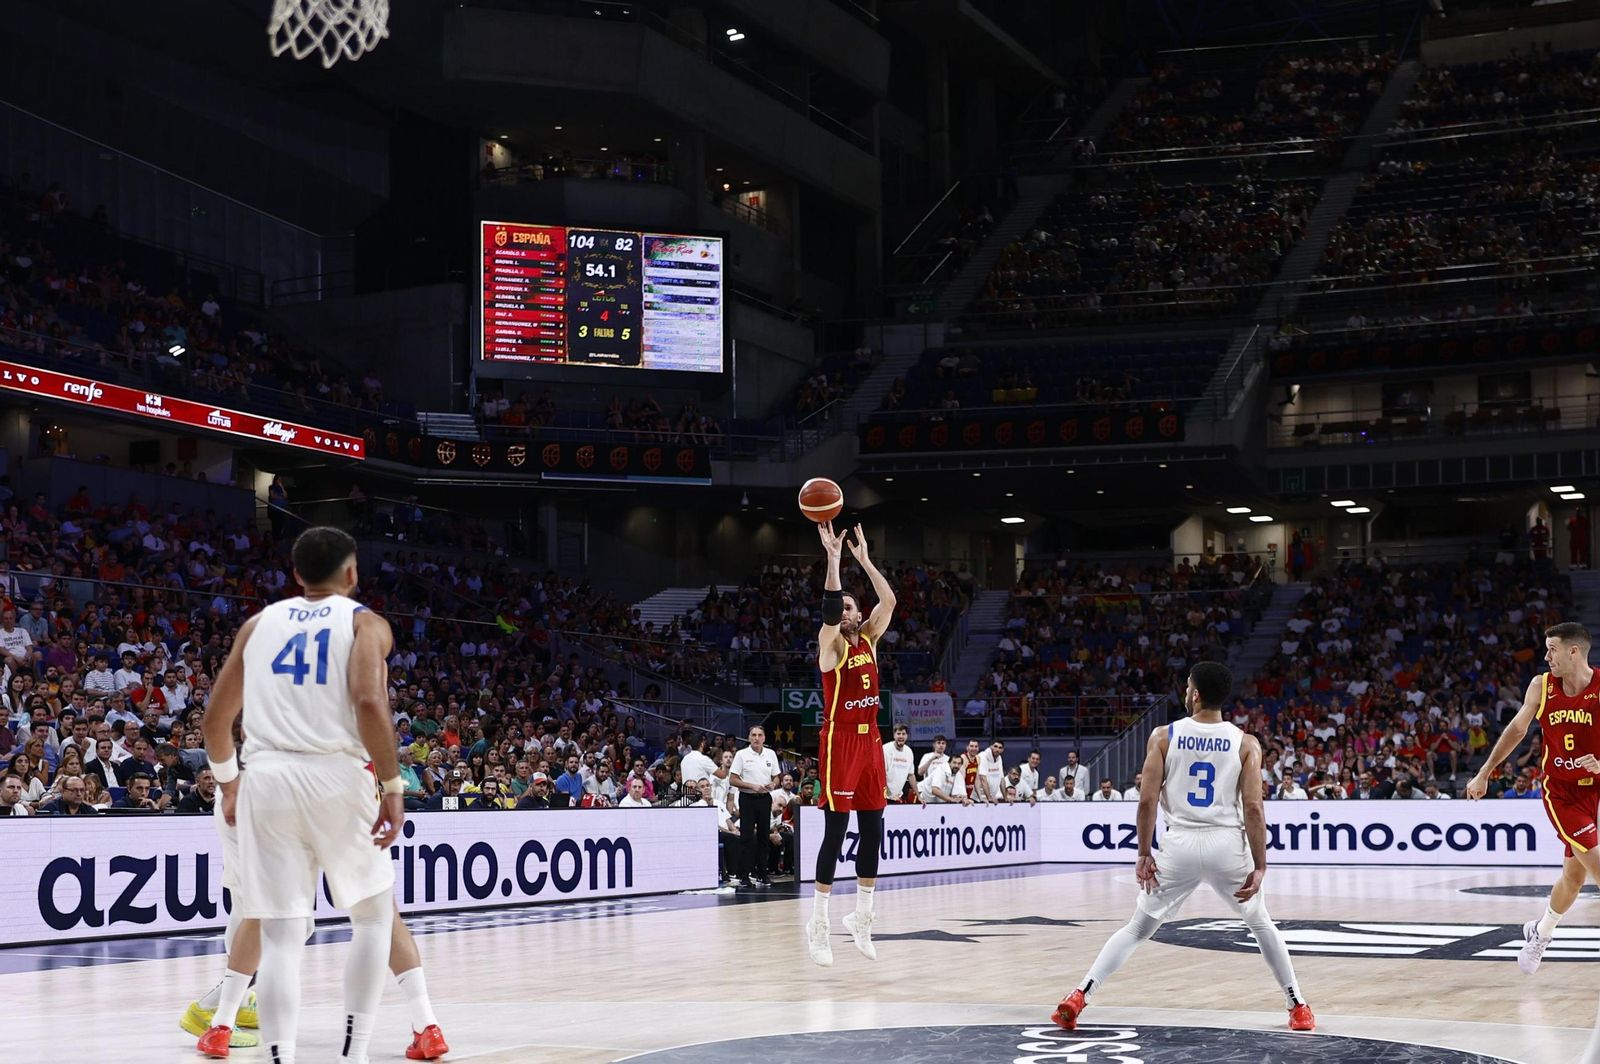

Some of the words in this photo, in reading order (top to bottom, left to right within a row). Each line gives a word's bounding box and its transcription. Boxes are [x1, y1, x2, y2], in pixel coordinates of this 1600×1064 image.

[513, 232, 551, 245] ESPAÑA
[569, 235, 595, 249] 104
[615, 238, 634, 251] 82
[585, 263, 616, 278] 54.1
[600, 310, 609, 321] 4
[578, 325, 588, 338] 3
[593, 327, 615, 338] FALTAS
[621, 328, 631, 340] 5
[64, 382, 103, 402] renfe
[207, 415, 231, 428] LOTUS
[263, 421, 298, 442] Kellogg's
[314, 436, 360, 452] VOLVO
[271, 627, 331, 686] 41
[861, 673, 870, 690] 5
[907, 698, 938, 706] RUDY
[911, 709, 944, 717] WIZINK
[1548, 708, 1593, 726] ESPAÑA
[1177, 736, 1231, 752] HOWARD
[1563, 733, 1575, 751] 6
[1187, 761, 1216, 807] 3
[839, 815, 1026, 865] zlmarino.com
[1082, 812, 1537, 852] azarino.com
[38, 820, 634, 931] azuino.com
